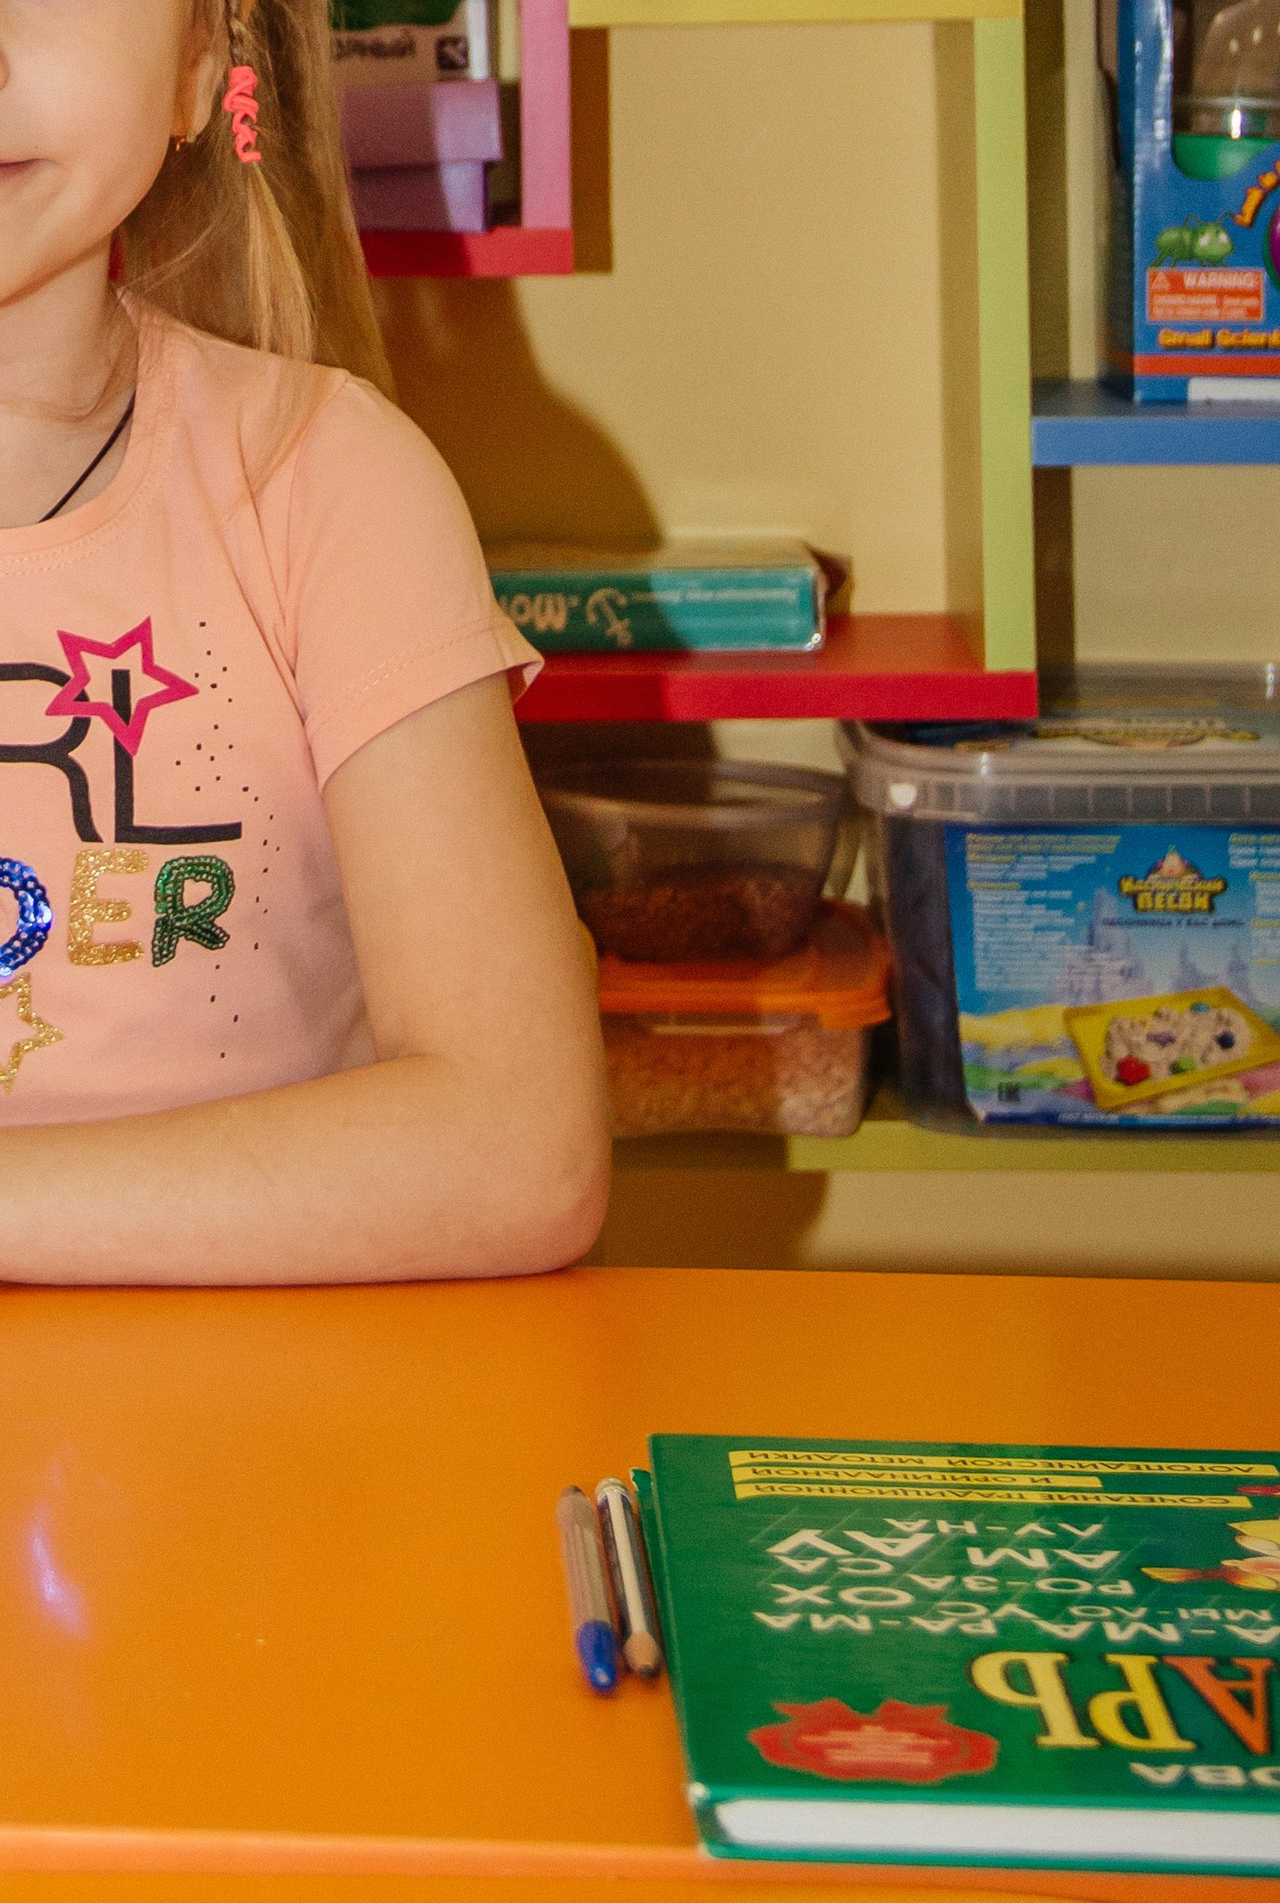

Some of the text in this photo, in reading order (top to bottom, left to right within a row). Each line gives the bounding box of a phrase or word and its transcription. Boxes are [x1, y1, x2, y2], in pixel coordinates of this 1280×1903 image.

[748, 1451, 1255, 1473] ЛОГОПЕДИЧЕСКОЙ МЕТОДИКИ
[751, 1468, 1051, 1485] И ОРИГИНАЛЬНОЙ
[754, 1484, 1231, 1505] СОЧЕТАНИЕ ТРАДИЦИОННОЙ
[883, 1518, 1104, 1539] ЛУ-НА
[765, 1529, 1121, 1570] АМ АУ
[773, 1556, 894, 1575] СА
[770, 1583, 915, 1607] ОХ
[907, 1574, 1135, 1597] РО-ЗА
[934, 1600, 1272, 1621] МЫ-ЛО УС
[752, 1611, 998, 1636] РА-МА
